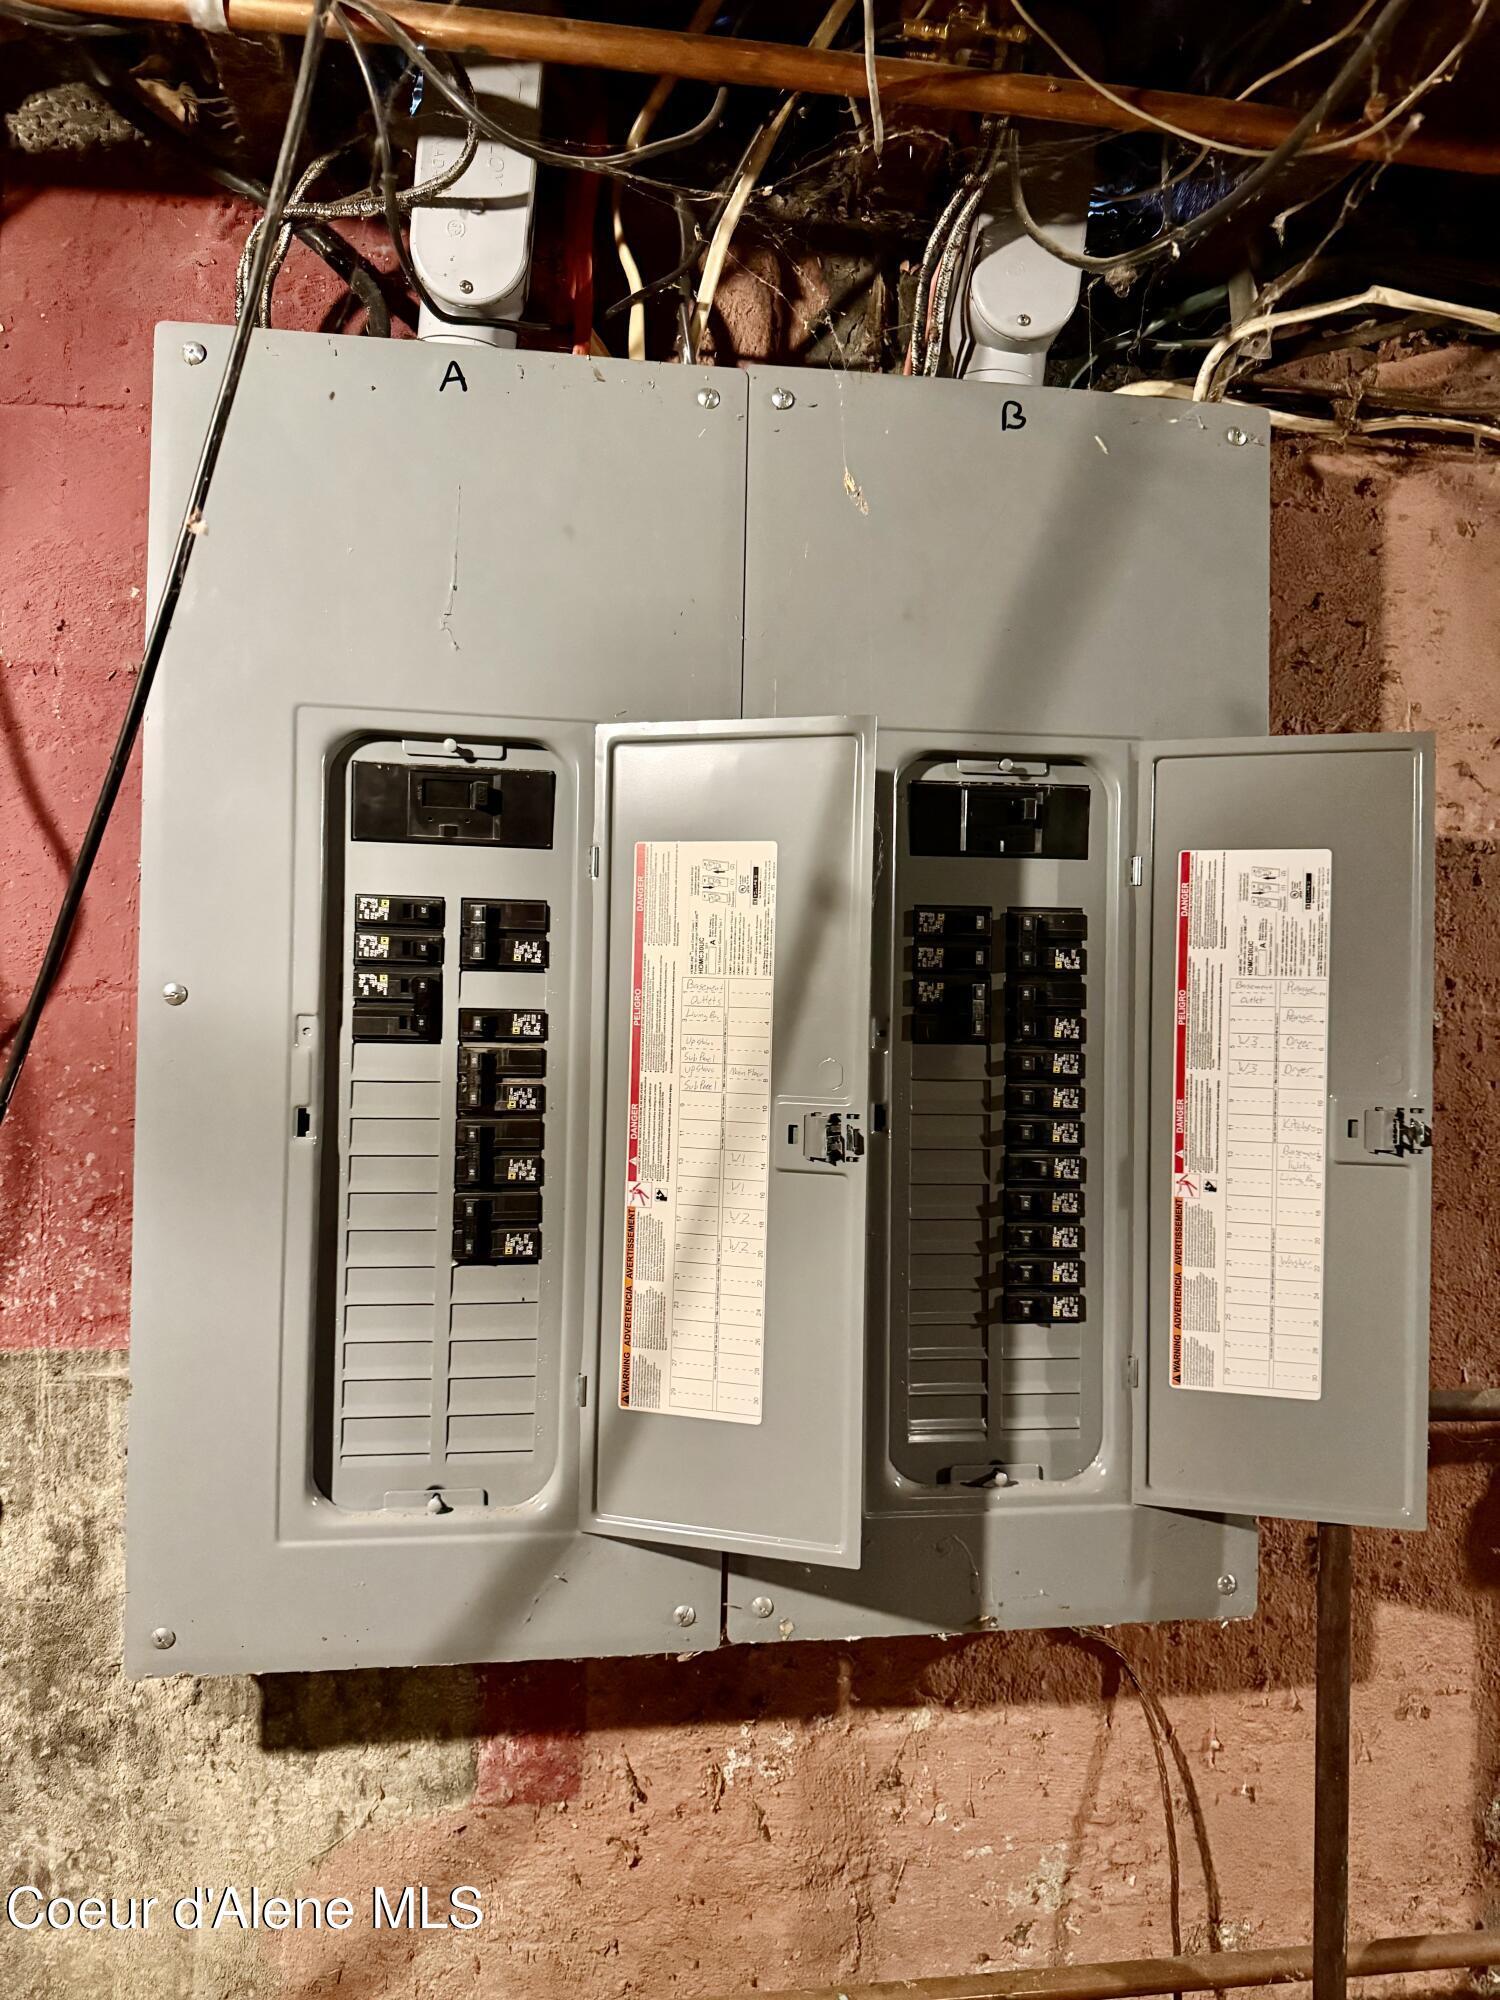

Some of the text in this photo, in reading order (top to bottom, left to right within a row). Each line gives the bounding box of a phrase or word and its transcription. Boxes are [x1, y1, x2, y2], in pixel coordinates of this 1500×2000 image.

[439, 362, 467, 392] A
[1002, 400, 1026, 430] B
[1180, 882, 1188, 917] DANGER
[1178, 989, 1186, 1026] PELIGRO
[630, 1104, 638, 1140] DANGER
[1176, 1099, 1184, 1134] DANGER
[626, 1208, 635, 1279] AVERTISSEMENT
[1175, 1200, 1183, 1266] AVERTISSEMENT
[624, 1285, 633, 1346] ADVERTENCIA
[1174, 1272, 1182, 1330] ADVERTENCIA
[1173, 1334, 1181, 1372] WARNING
[622, 1352, 630, 1393] WARNING
